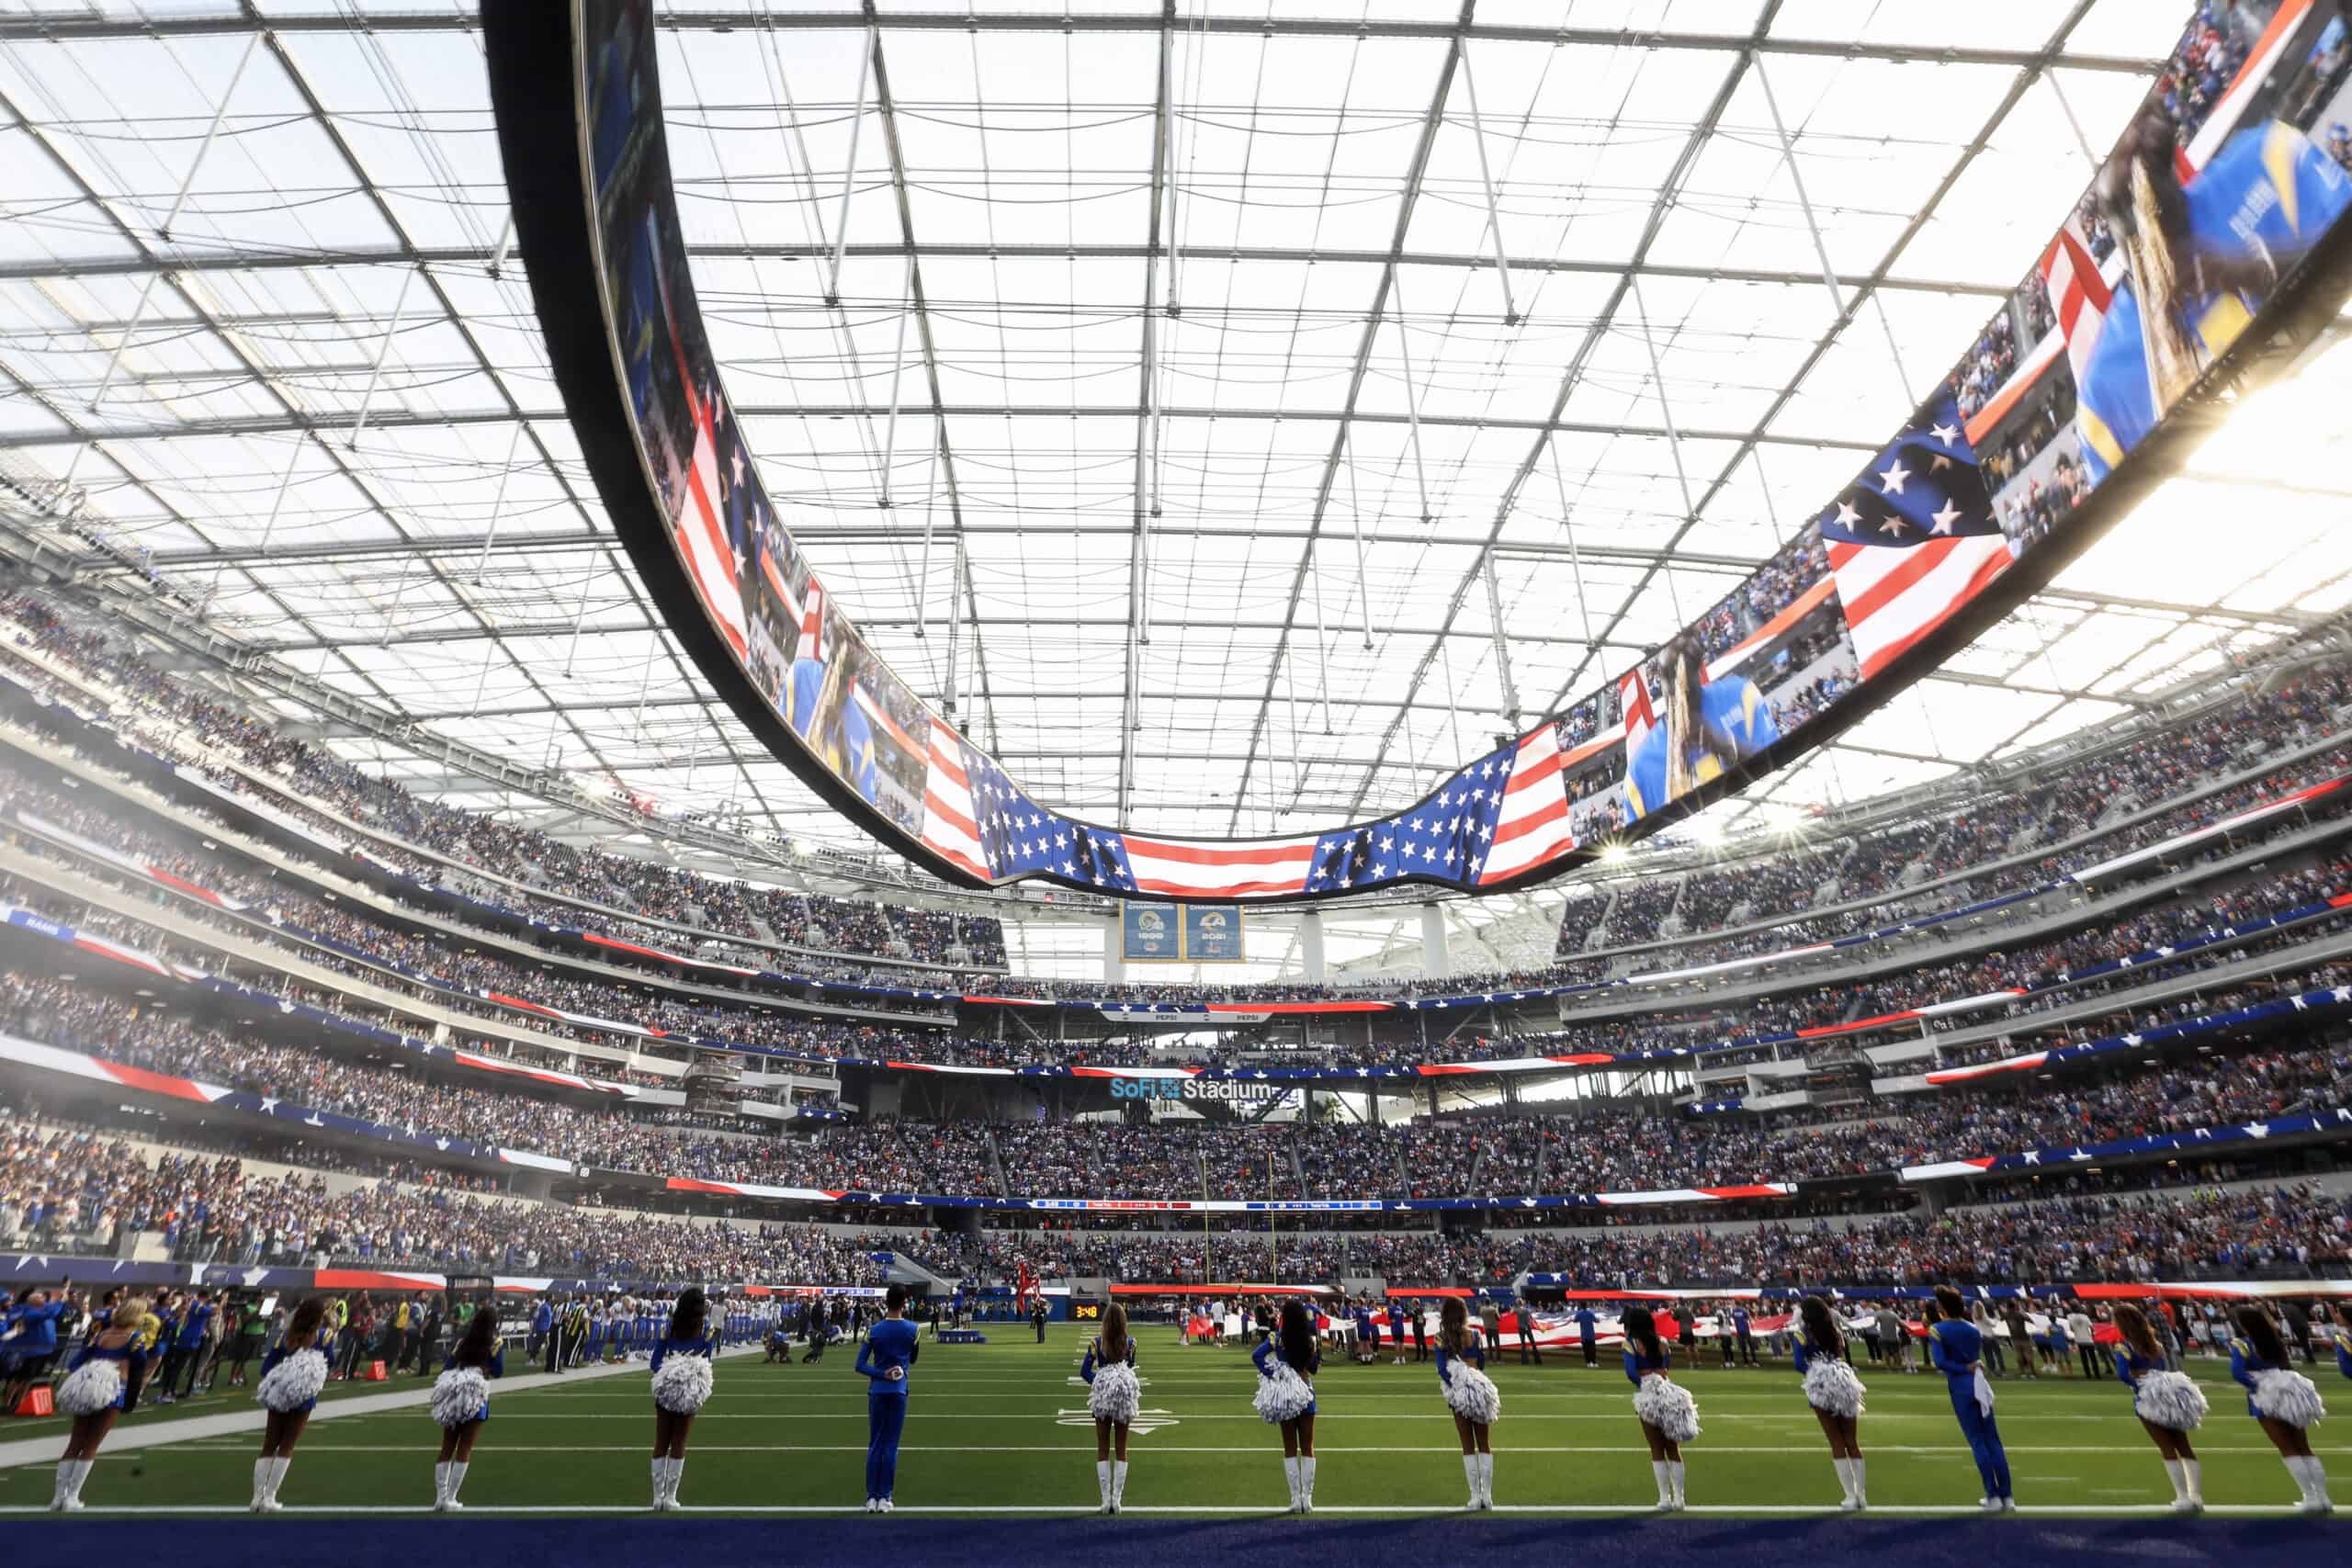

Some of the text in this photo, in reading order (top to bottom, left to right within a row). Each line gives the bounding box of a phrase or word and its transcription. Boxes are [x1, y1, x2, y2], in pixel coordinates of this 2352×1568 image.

[1110, 1077, 1272, 1100] SoFi Stadium
[1076, 1305, 1097, 1318] 3:48
